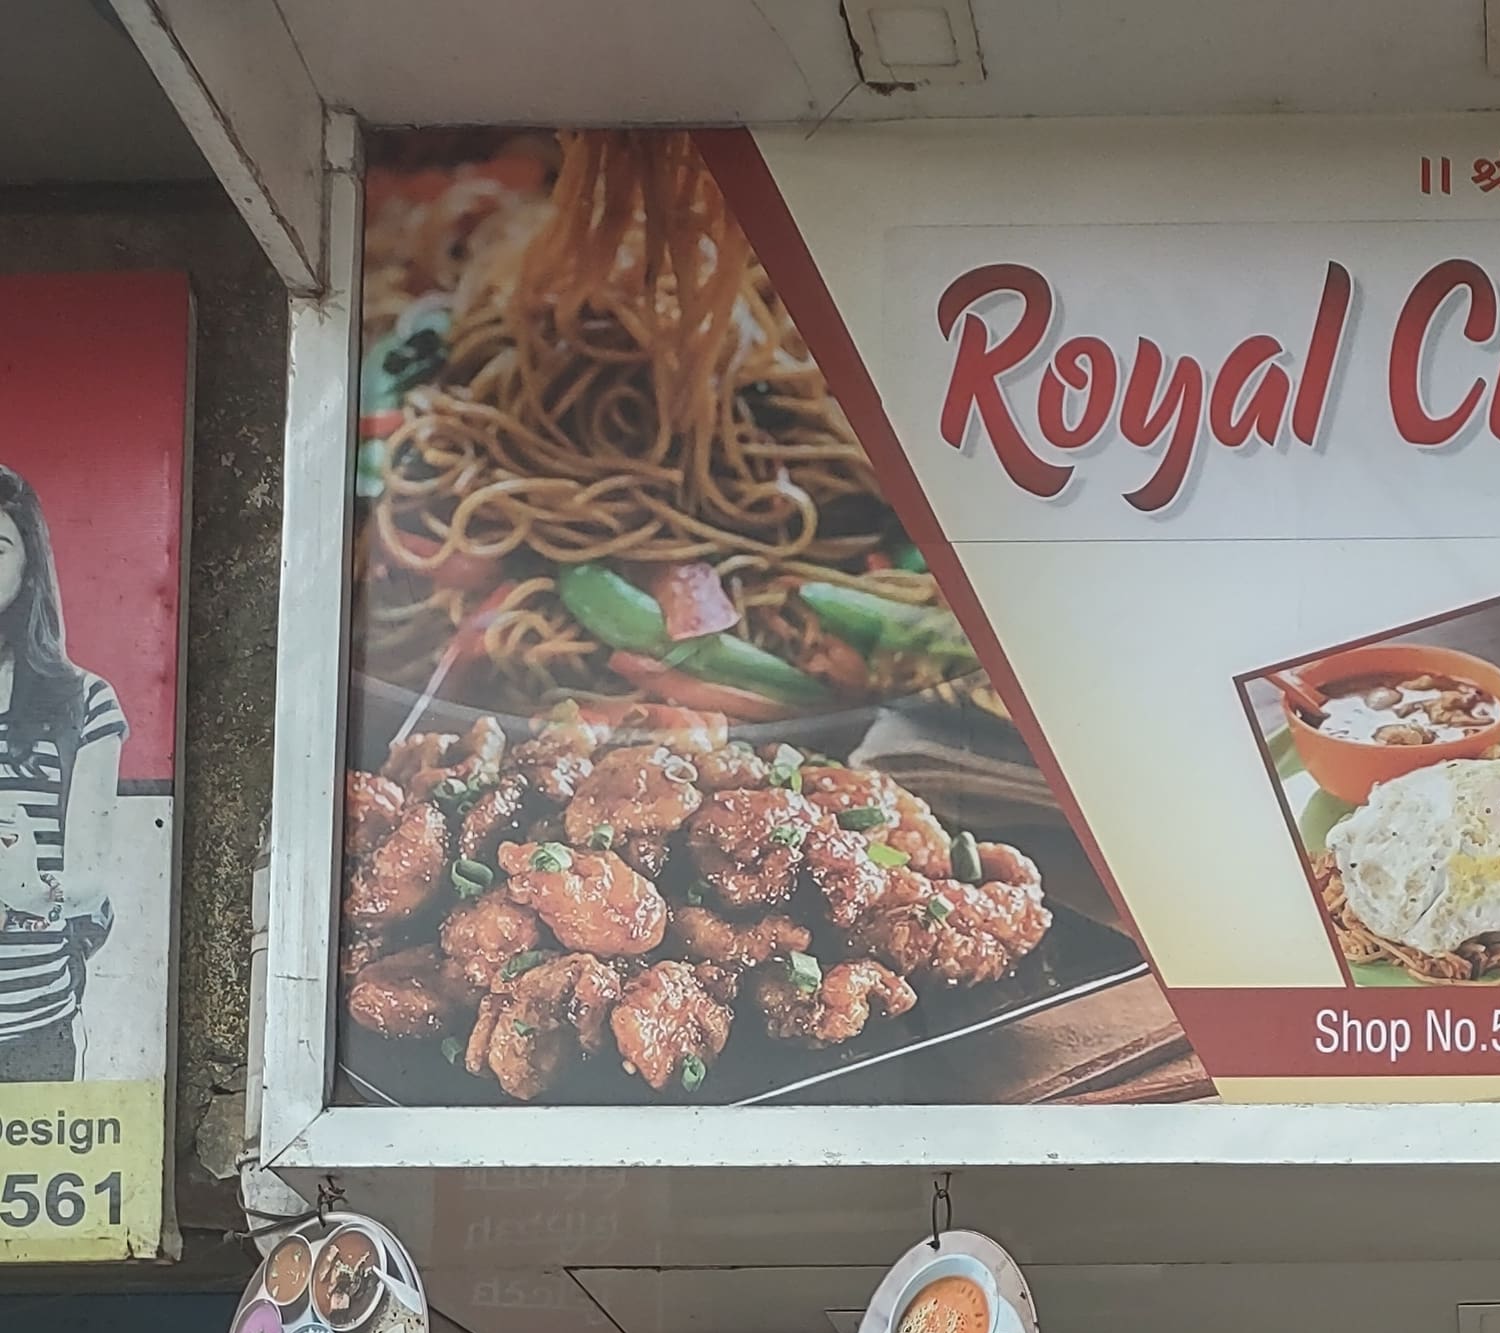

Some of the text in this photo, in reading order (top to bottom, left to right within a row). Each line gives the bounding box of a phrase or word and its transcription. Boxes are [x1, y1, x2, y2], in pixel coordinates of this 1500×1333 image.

[937, 259, 1354, 514] Royal
[1315, 1008, 1411, 1061] Shop
[0, 1110, 121, 1154] esign
